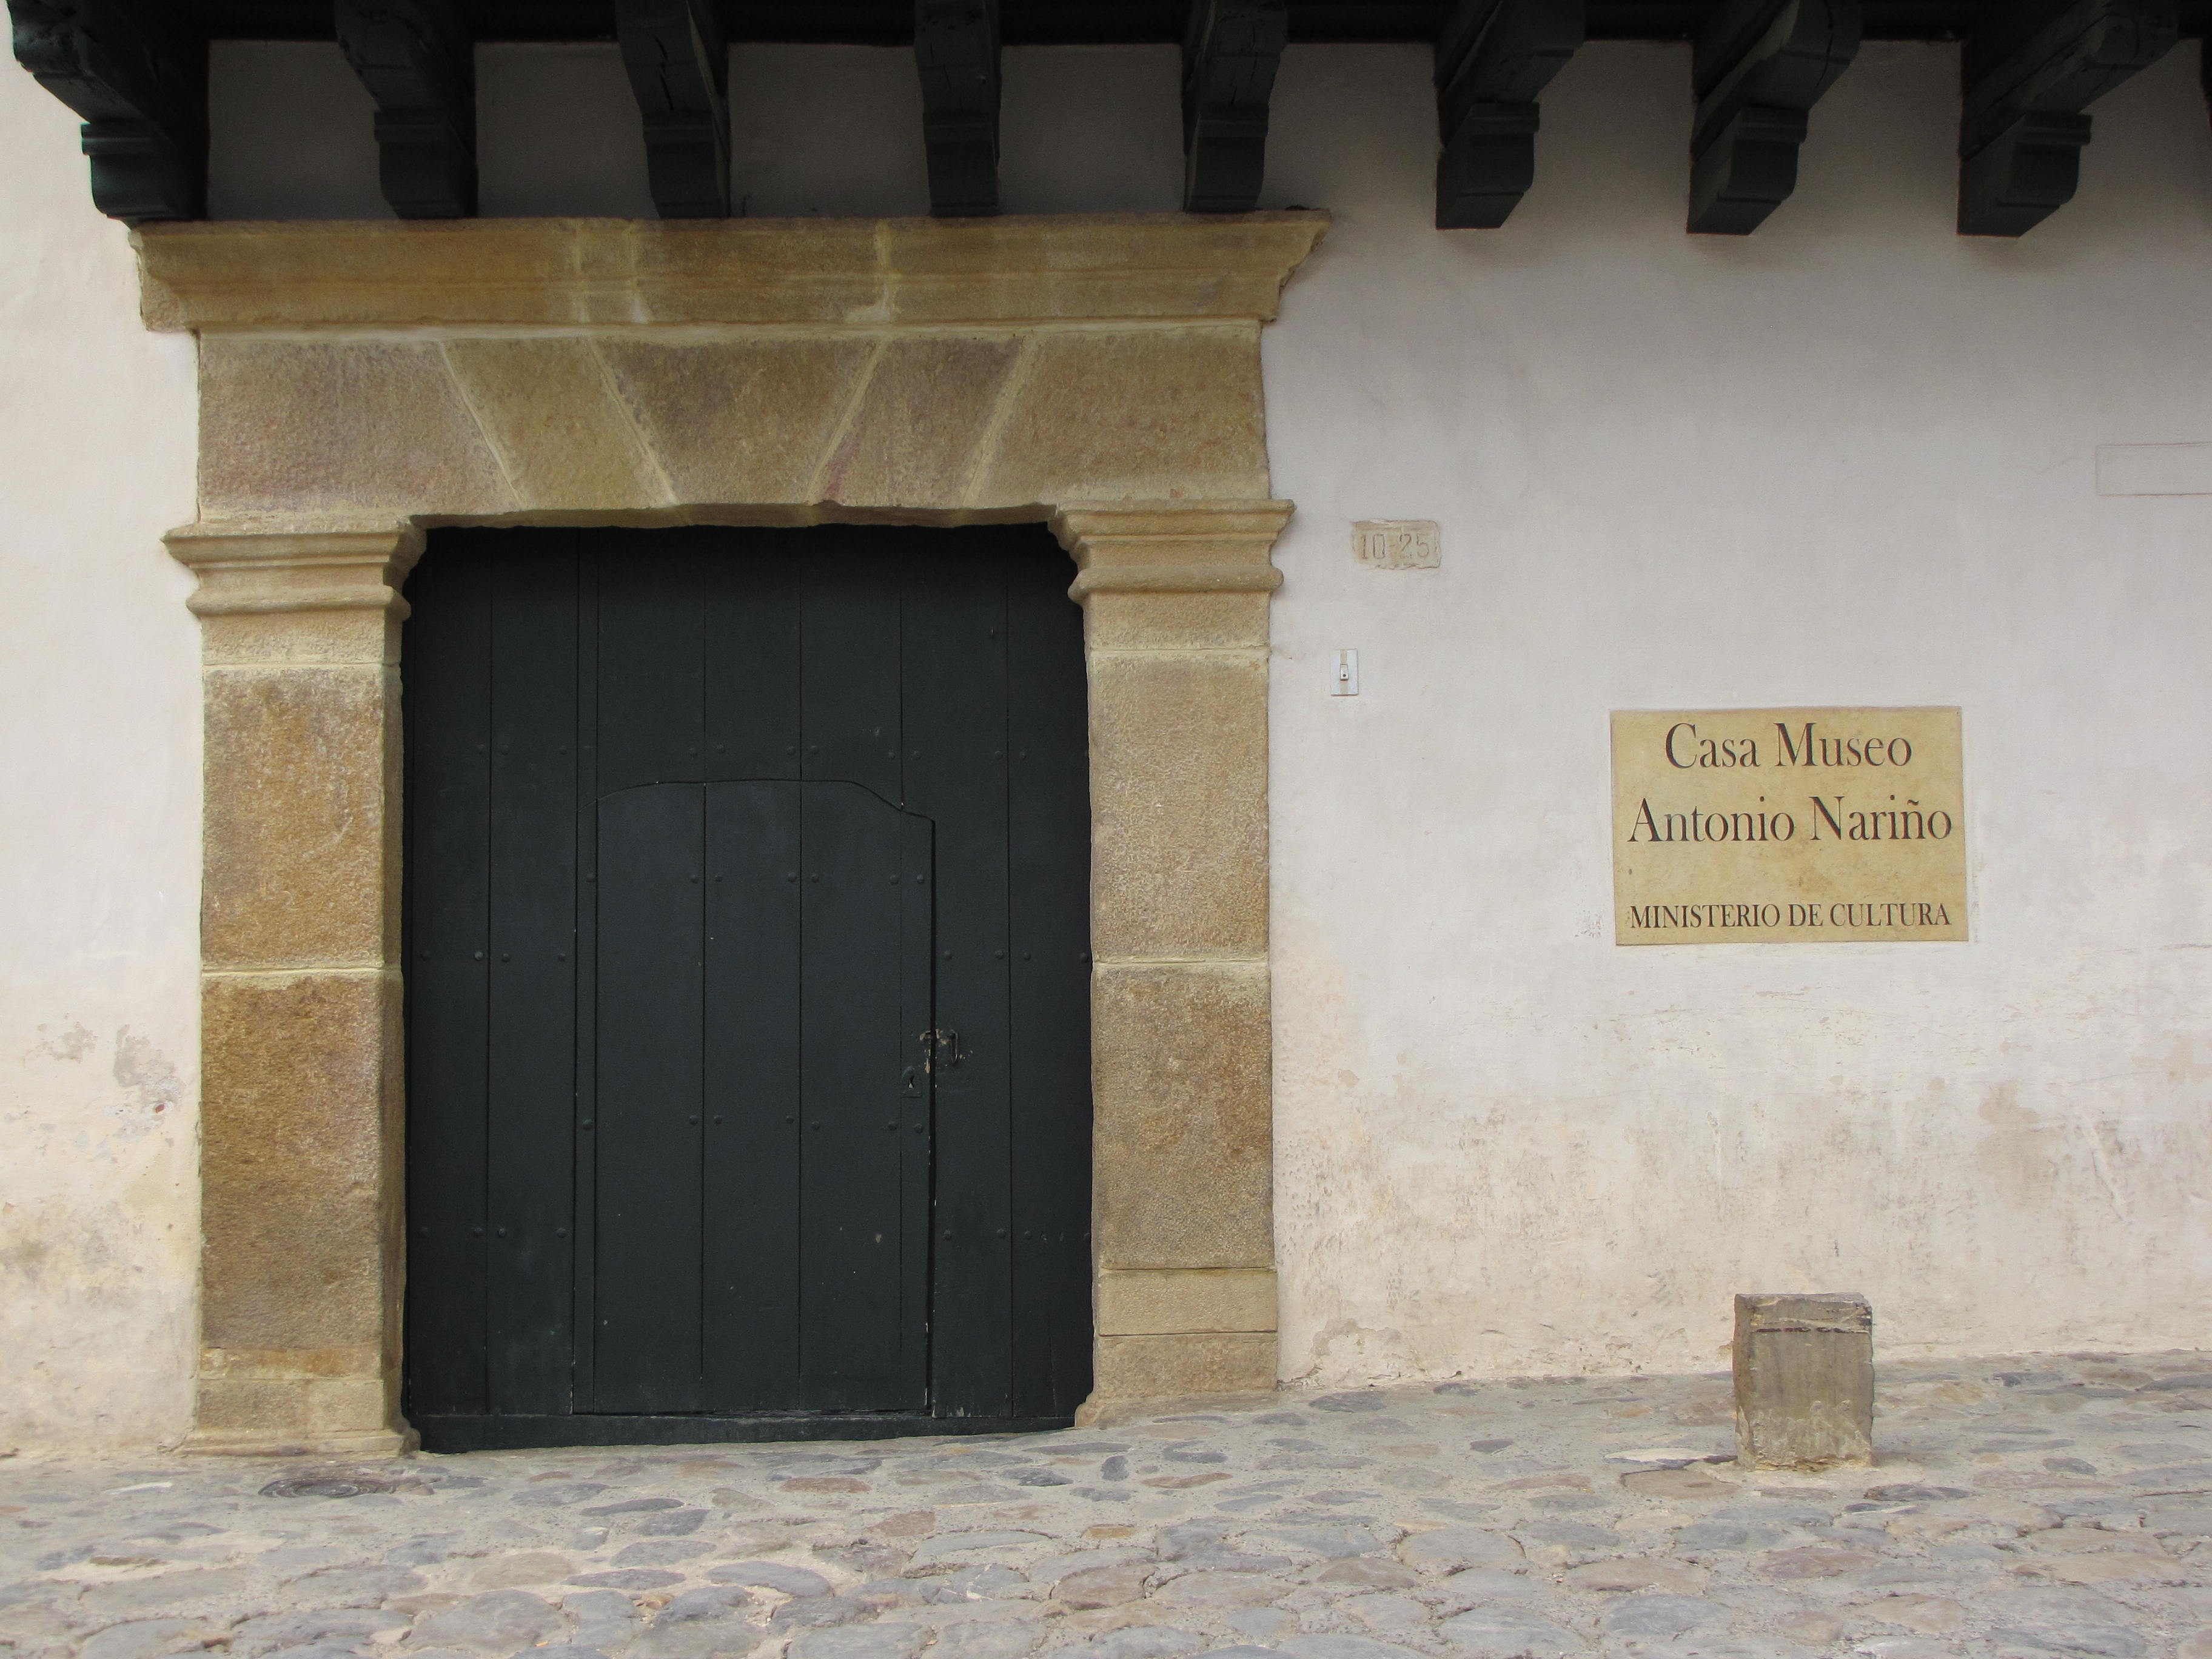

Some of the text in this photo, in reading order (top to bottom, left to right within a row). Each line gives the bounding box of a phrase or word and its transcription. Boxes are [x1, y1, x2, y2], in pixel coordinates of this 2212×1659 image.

[1665, 722, 1912, 769] Casa Museo
[1627, 794, 1952, 842] Antonio Nariño
[1630, 902, 1952, 928] MINISTERIO DE CULTURA
